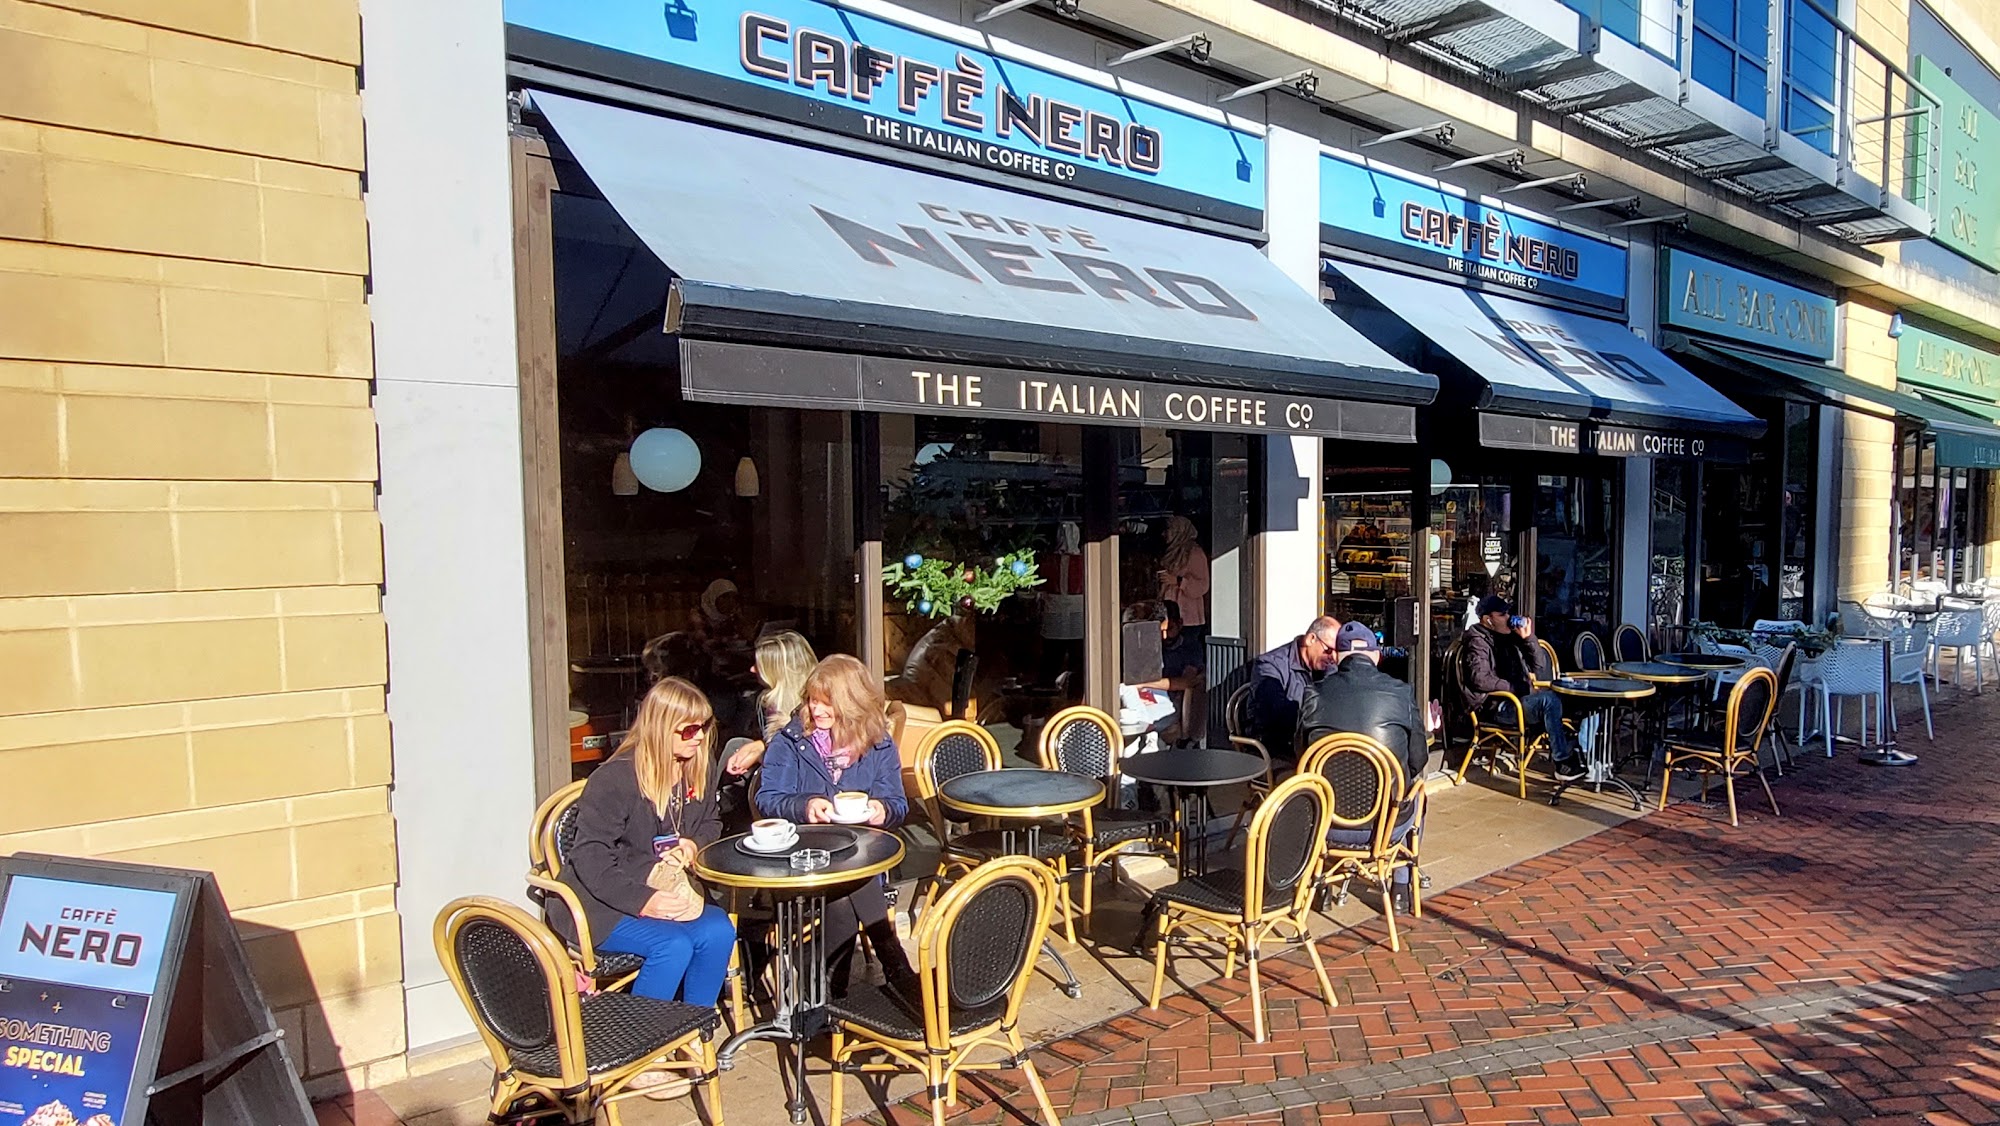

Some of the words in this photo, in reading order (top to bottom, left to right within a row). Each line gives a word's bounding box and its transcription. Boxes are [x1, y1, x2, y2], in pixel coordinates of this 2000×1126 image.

[740, 11, 985, 129] CAFFÈ
[995, 83, 1162, 174] NERO
[863, 115, 900, 141] THE
[906, 125, 981, 161] ITALIAN
[986, 145, 1050, 177] COFFEE
[1958, 103, 1978, 142] ALL
[1954, 150, 1978, 195] BAR
[917, 201, 1111, 252] CAFFÈ
[1401, 201, 1501, 260] CAFFÈ
[1504, 230, 1579, 280] NERO
[1950, 206, 1978, 247] ONE
[808, 203, 1258, 321] NERO
[1447, 257, 1463, 272] THE
[1465, 263, 1497, 280] ITALIAN
[1498, 270, 1526, 287] COFFEE
[1680, 268, 1726, 321] ALL
[1737, 283, 1778, 335] BAR
[1784, 299, 1827, 345] ONE
[1464, 325, 1668, 386] NERO
[1915, 338, 1938, 374] ALL
[1942, 348, 1964, 382] BAR
[1967, 355, 1992, 387] ONE
[912, 371, 982, 407] THE
[1020, 380, 1141, 417] ITALIAN
[1165, 392, 1266, 426] COFFEE
[1550, 426, 1576, 448] THE
[1588, 429, 1635, 451] ITALIAN
[1643, 435, 1685, 455] COFFEE
[60, 907, 118, 925] CAFFÈ
[18, 920, 143, 968] NERO
[0, 1017, 112, 1053] SOMETHING
[4, 1045, 86, 1077] SPECIAL
